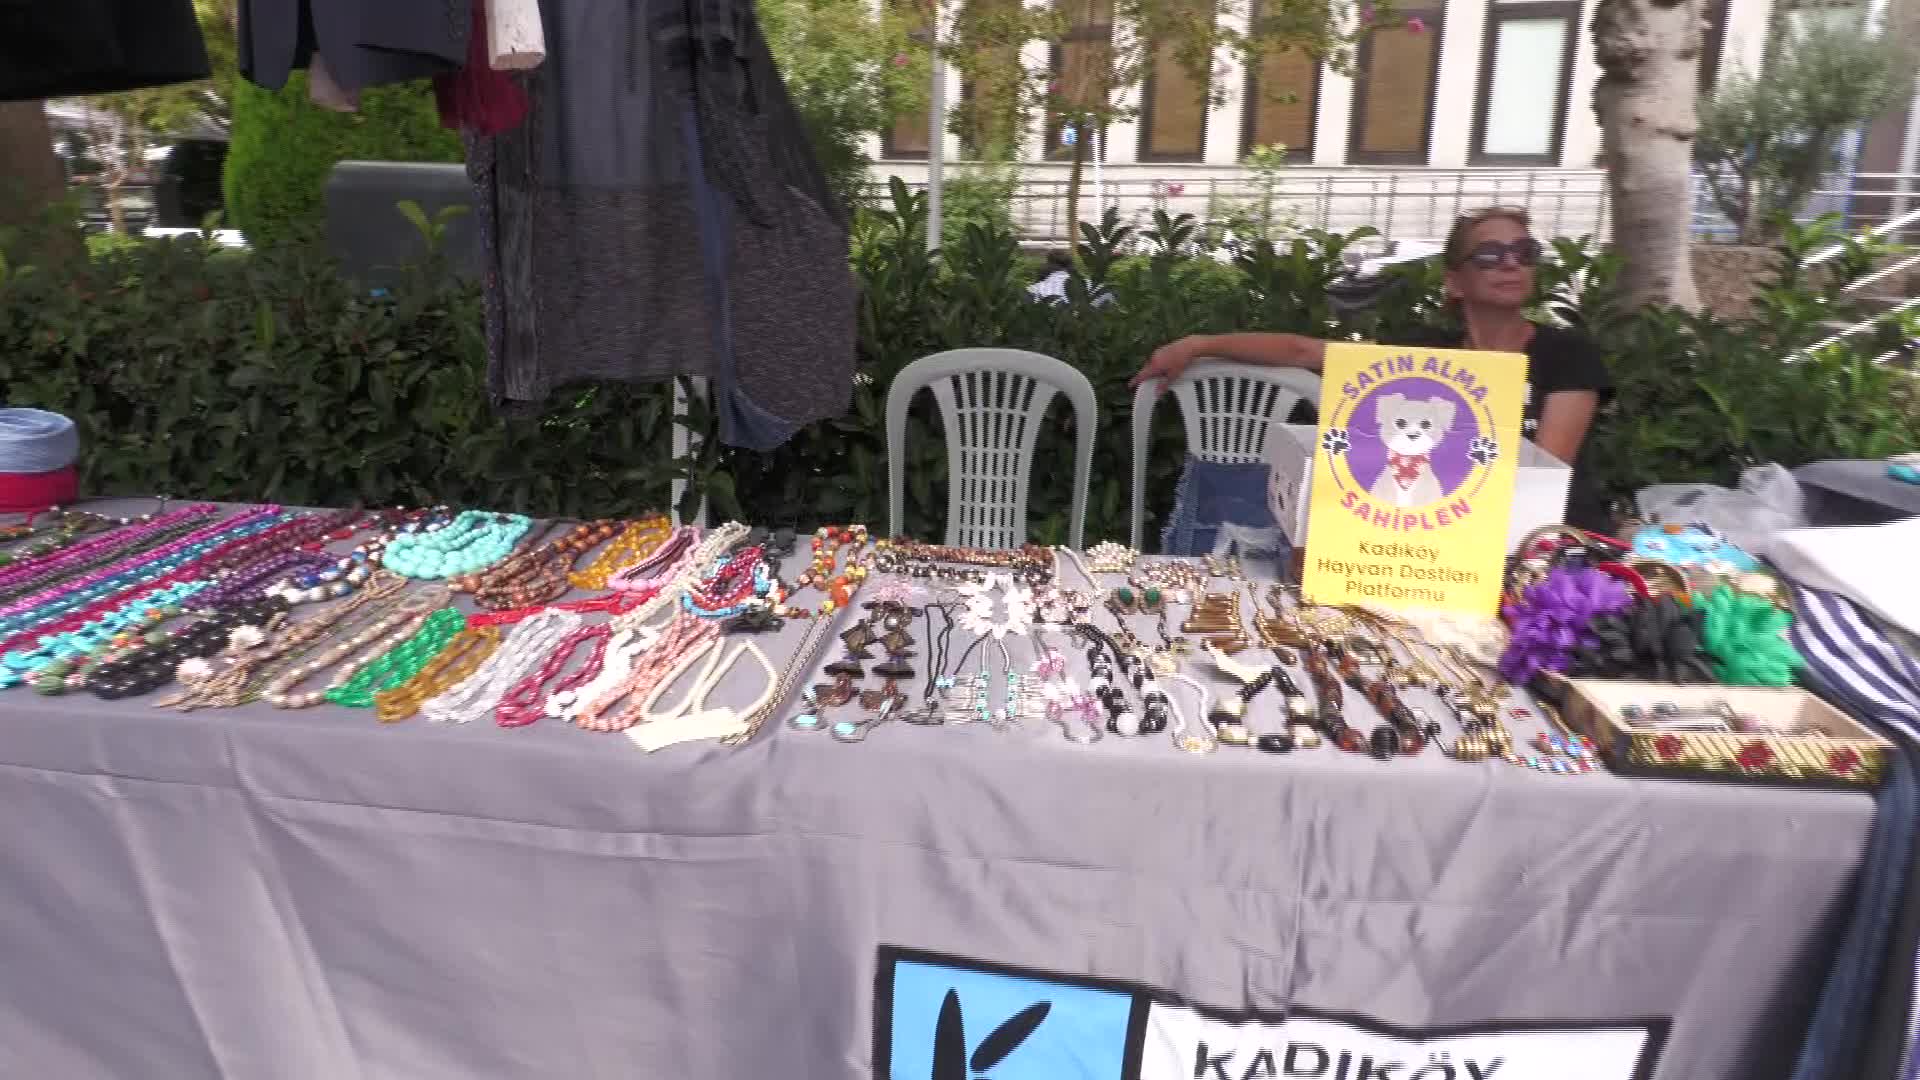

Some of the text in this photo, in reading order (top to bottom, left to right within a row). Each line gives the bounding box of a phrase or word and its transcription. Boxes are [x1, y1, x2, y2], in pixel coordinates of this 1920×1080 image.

[1342, 354, 1488, 402] SATIN ALMA
[1341, 490, 1472, 531] SAHİPLEN
[1318, 558, 1393, 578] Hayvan
[1346, 580, 1445, 602] Platformu
